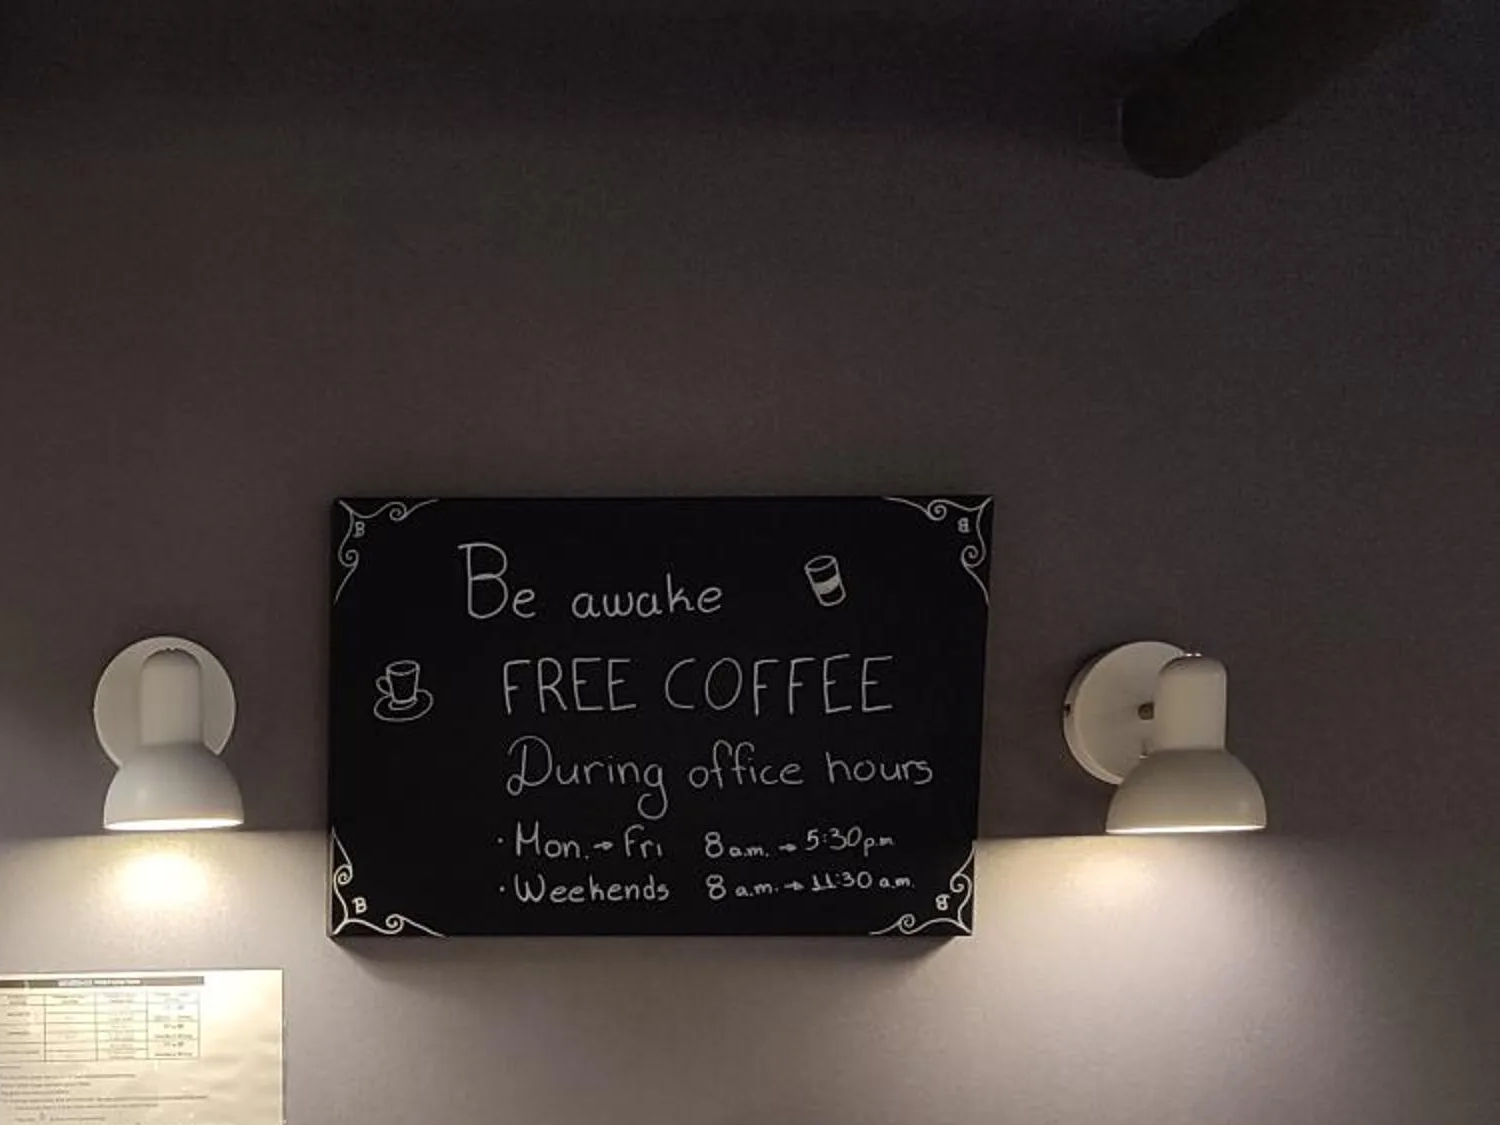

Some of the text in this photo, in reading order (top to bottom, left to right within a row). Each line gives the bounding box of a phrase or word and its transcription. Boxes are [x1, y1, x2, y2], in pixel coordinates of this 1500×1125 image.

[458, 543, 722, 619] Be awake
[504, 654, 892, 716] FREE COFFEE
[507, 736, 932, 819] During office hours
[516, 821, 588, 859] Mon.
[625, 824, 662, 858] Fri
[515, 874, 669, 902] Weekends
